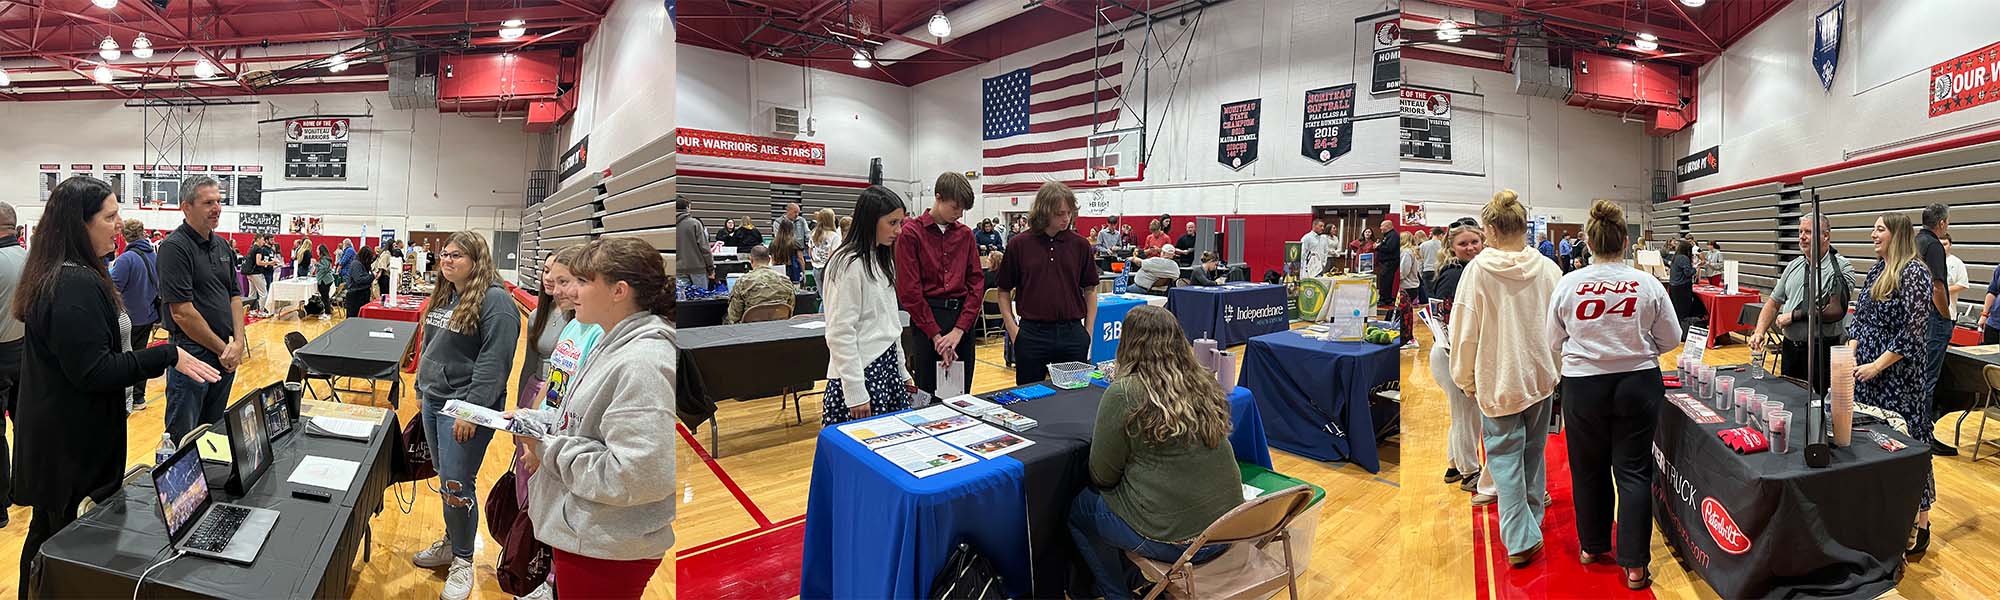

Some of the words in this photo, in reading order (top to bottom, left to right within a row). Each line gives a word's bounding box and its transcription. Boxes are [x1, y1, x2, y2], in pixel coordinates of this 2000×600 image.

[1953, 66, 1986, 94] OUR
[1307, 88, 1352, 104] MONITEAU
[1415, 91, 1427, 99] THE
[1223, 103, 1256, 114] MONITEAU
[1307, 99, 1350, 113] SOFTBALL
[1229, 112, 1249, 121] STATE
[1322, 111, 1340, 119] CLASS
[1222, 118, 1255, 129] CHAMPION
[1304, 120, 1320, 129] STATE
[1320, 118, 1343, 127] RUNNER
[1314, 126, 1339, 139] 2016
[676, 135, 701, 148] OUR
[702, 138, 758, 153] WARRIORS
[760, 144, 780, 155] ARE
[781, 147, 811, 158] STARS
[1313, 136, 1338, 150] 24-2
[1575, 280, 1640, 296] PINK
[1236, 304, 1284, 323] Independence
[1575, 297, 1638, 321] 04
[1665, 459, 1697, 511] TRUCK
[1704, 501, 1741, 547] Peterbilt
